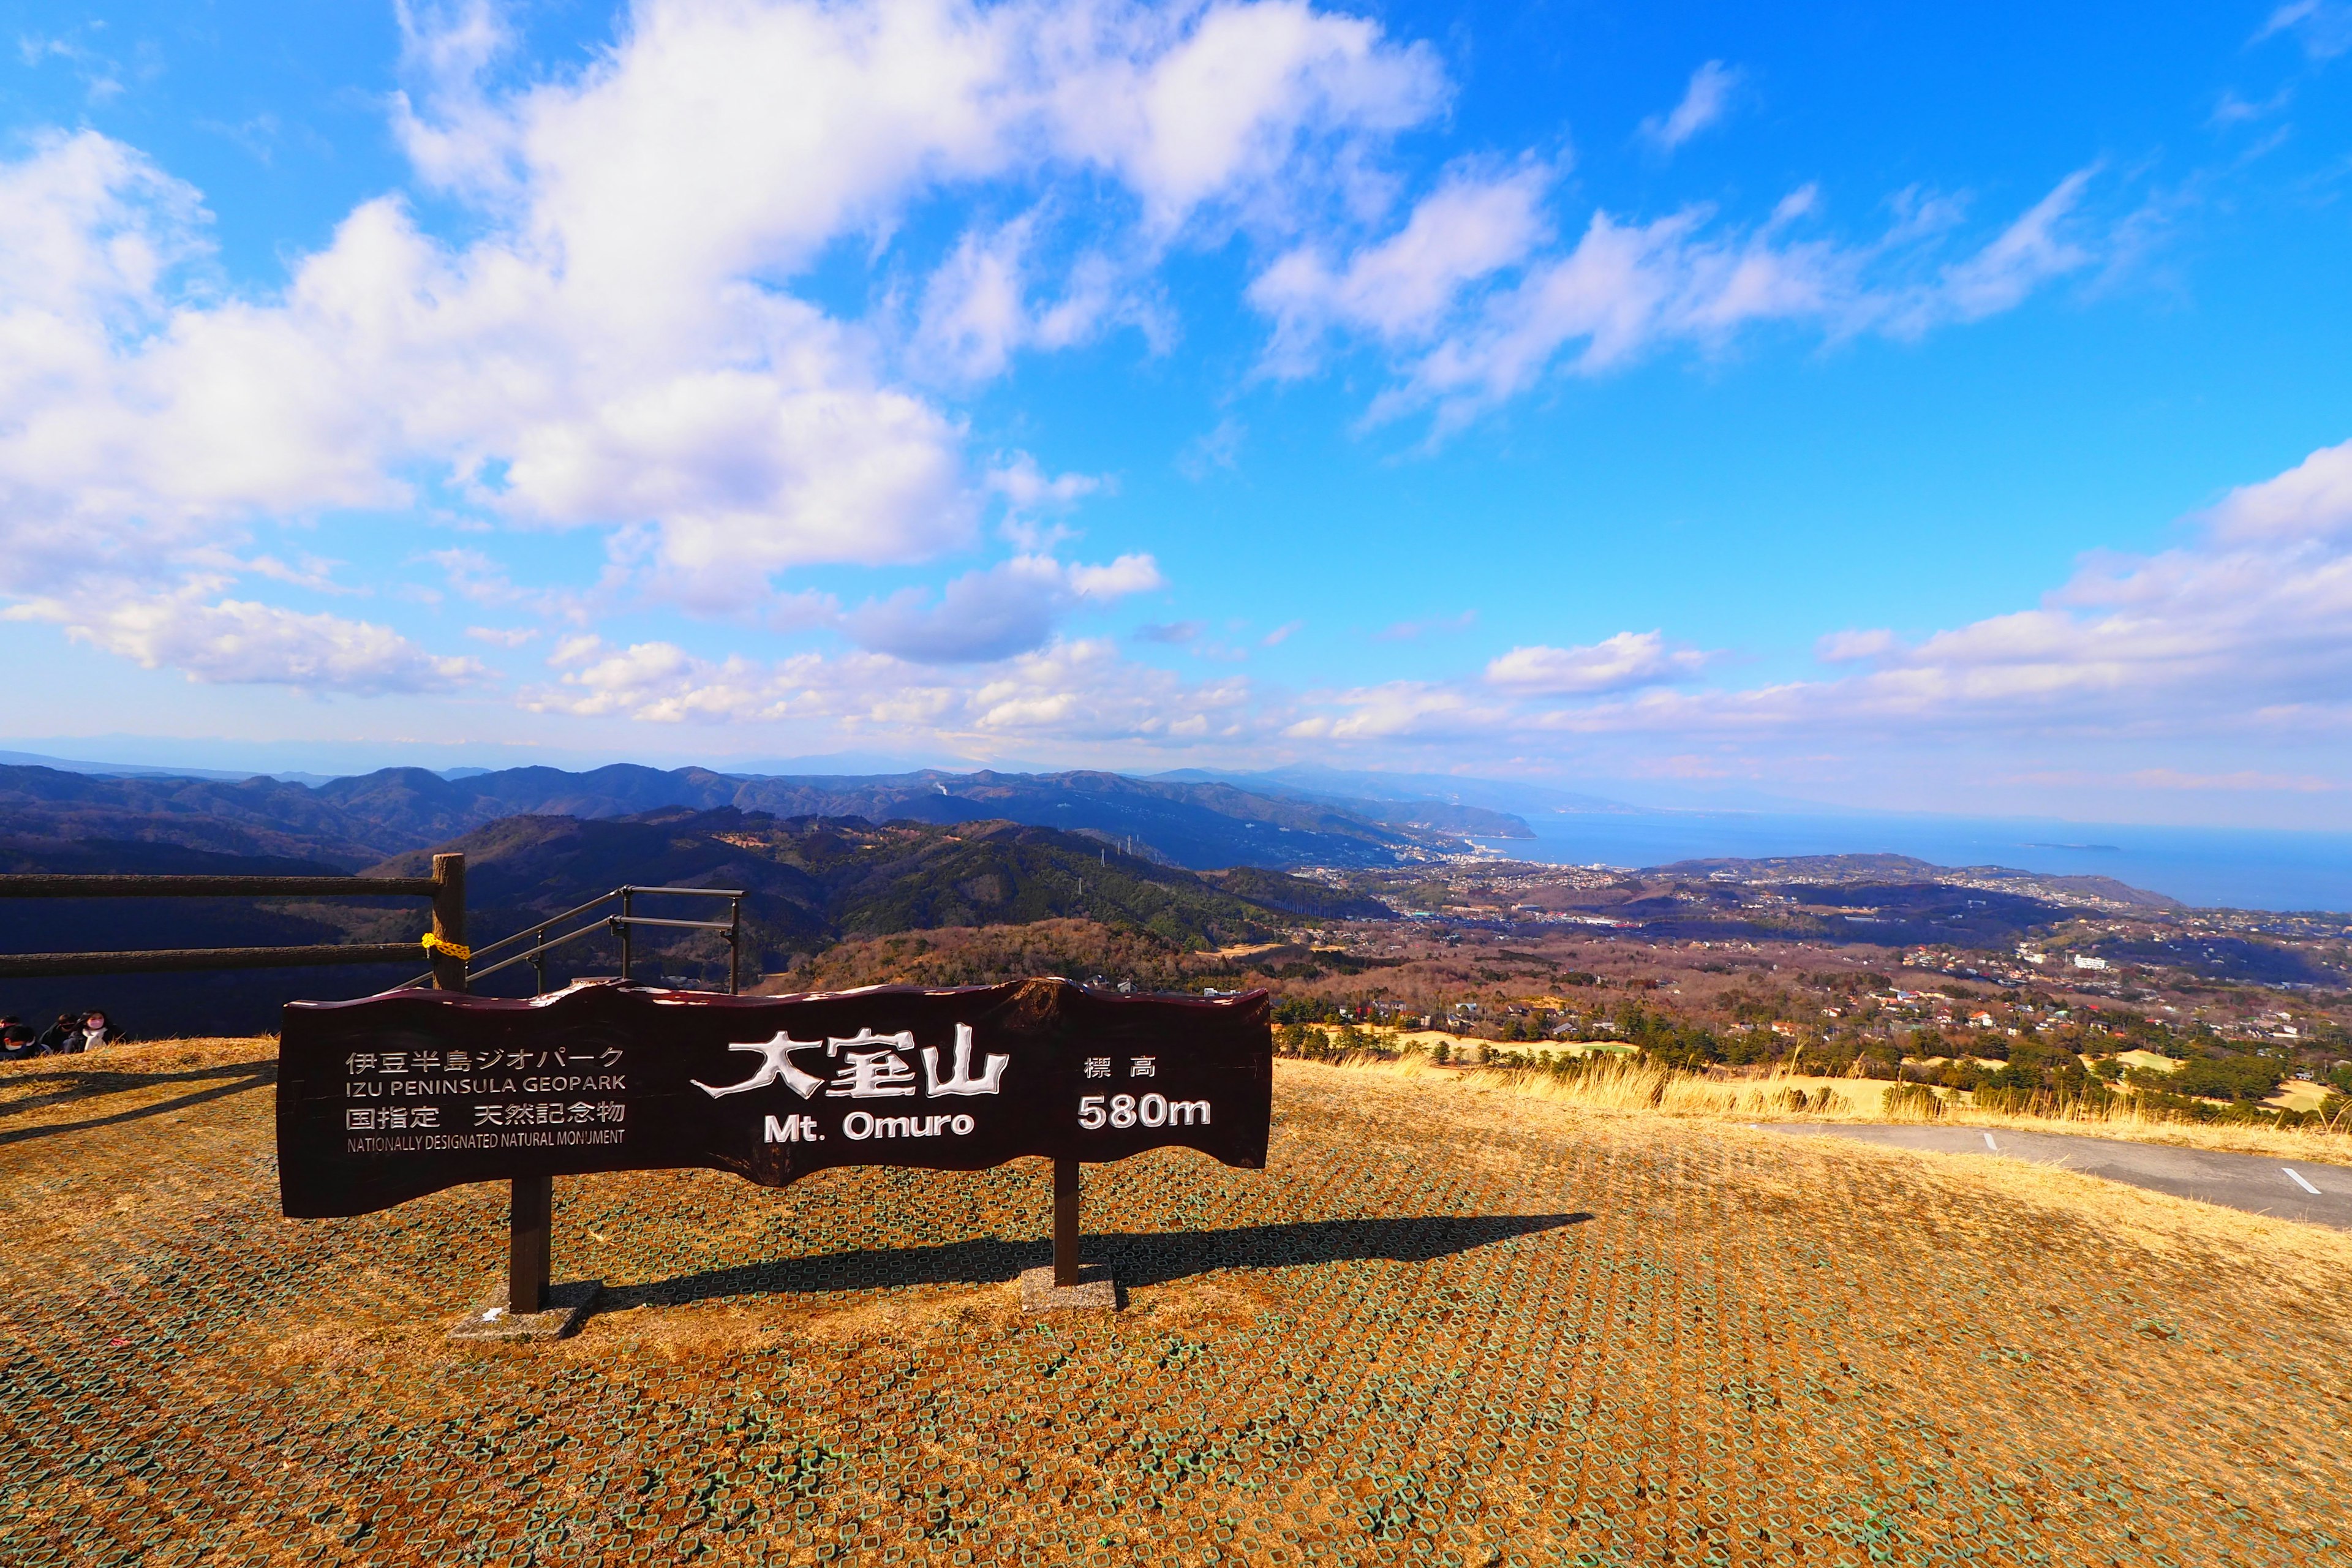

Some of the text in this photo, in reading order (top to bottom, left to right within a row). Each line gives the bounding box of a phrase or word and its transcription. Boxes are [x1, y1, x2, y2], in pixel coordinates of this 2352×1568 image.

[345, 1046, 624, 1075] 伊豆半島ジオパーク
[690, 1021, 1010, 1100] 大室山
[346, 1075, 626, 1098] IZU PENINSULA GEOPARK
[346, 1101, 625, 1131] 国指定 天然記念物
[1077, 1092, 1211, 1130] 580m
[349, 1129, 625, 1152] NATIONALLY DESIGNATED NATURAL MONUMENT
[764, 1111, 975, 1143] Mt. Omuro
